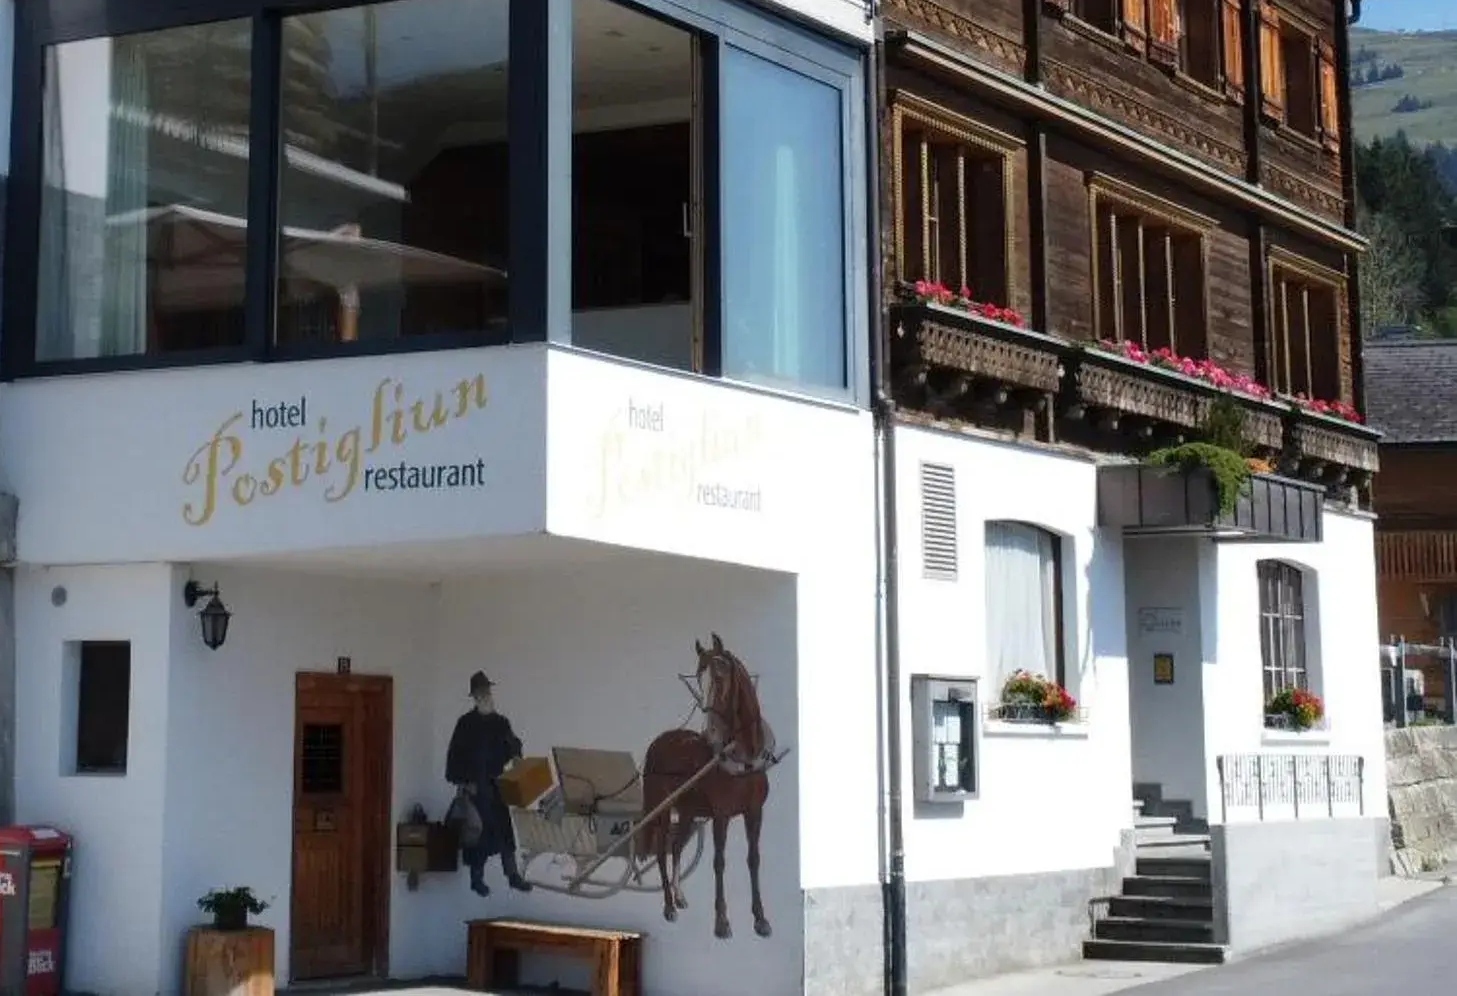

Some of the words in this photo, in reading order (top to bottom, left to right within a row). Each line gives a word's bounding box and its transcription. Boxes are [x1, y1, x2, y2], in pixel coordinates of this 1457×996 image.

[251, 395, 307, 429] hotel
[628, 395, 664, 432] hotel
[182, 372, 488, 527] Postigliun
[364, 458, 485, 492] restaurant
[697, 482, 761, 513] restaurant
